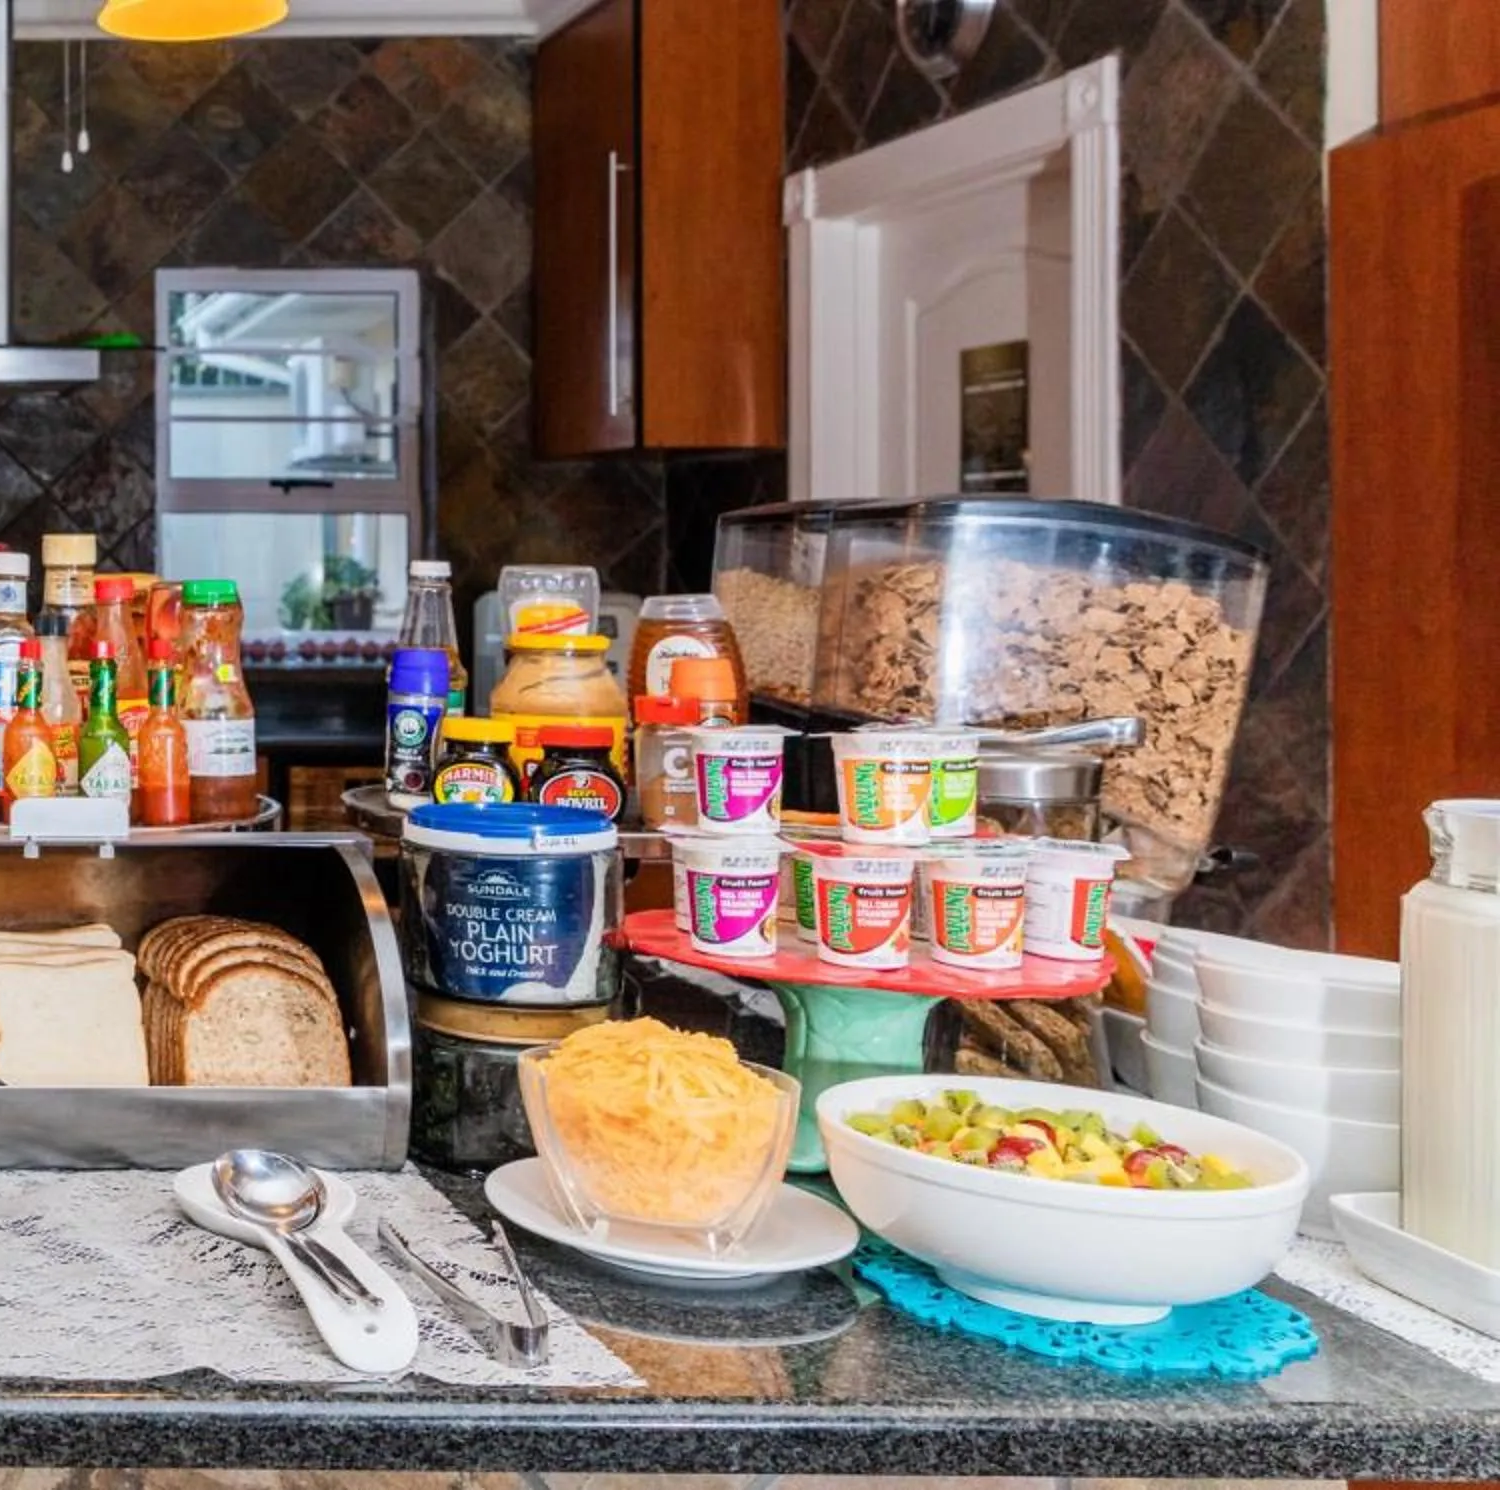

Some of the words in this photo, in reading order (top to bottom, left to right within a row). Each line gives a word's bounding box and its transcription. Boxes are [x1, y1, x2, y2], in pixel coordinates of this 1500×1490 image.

[468, 884, 531, 897] SUNDALE
[446, 904, 500, 921] DOUBLE
[506, 908, 557, 923] CREAM
[467, 922, 534, 943] PLAIN
[450, 939, 558, 965] YOGHURT
